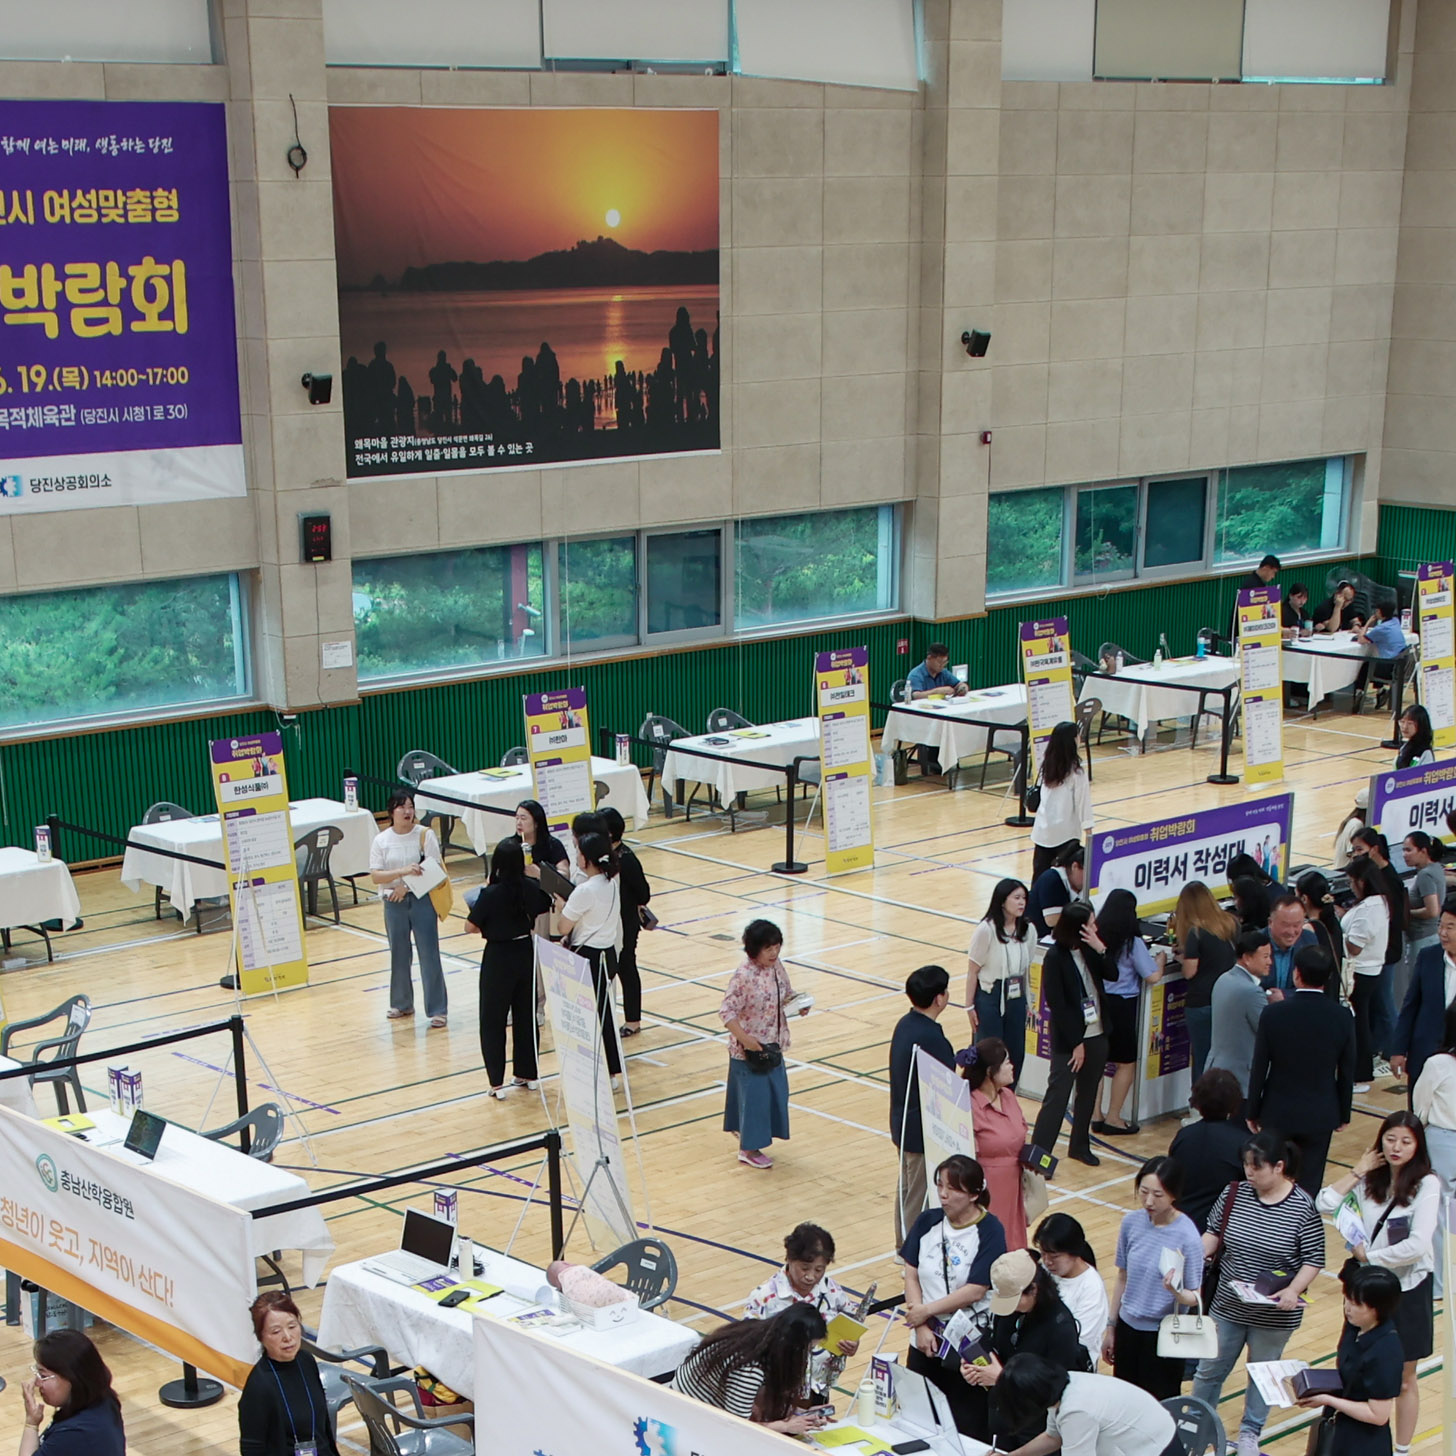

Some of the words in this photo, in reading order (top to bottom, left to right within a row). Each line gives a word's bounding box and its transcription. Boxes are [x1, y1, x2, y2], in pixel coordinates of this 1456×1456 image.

[1, 136, 30, 155] 함께
[34, 137, 59, 155] 여는
[148, 135, 174, 154] 당진
[43, 188, 180, 224] 여성맞춤형
[94, 365, 189, 389] 14:00~17:00
[80, 406, 119, 426] (당진시
[166, 403, 189, 422] 30)
[354, 436, 388, 450] 왜목마을
[355, 453, 388, 466] 전국에서
[390, 451, 422, 463] 유일하게
[469, 446, 484, 457] 모두
[487, 446, 495, 457] 볼
[497, 445, 506, 455] 수
[507, 443, 523, 455] 있는
[525, 442, 534, 454] 곳
[29, 472, 112, 495] 당진상공회의소
[1409, 796, 1454, 829] 이력서
[1150, 819, 1196, 842] 취업박람회
[1134, 852, 1188, 890] 이력서
[60, 1169, 135, 1220] 충남산학융합원
[0, 1196, 44, 1244] 청년이
[49, 1221, 84, 1266] 웃고,
[88, 1237, 135, 1289] 지역이
[138, 1263, 175, 1307] 산다!
